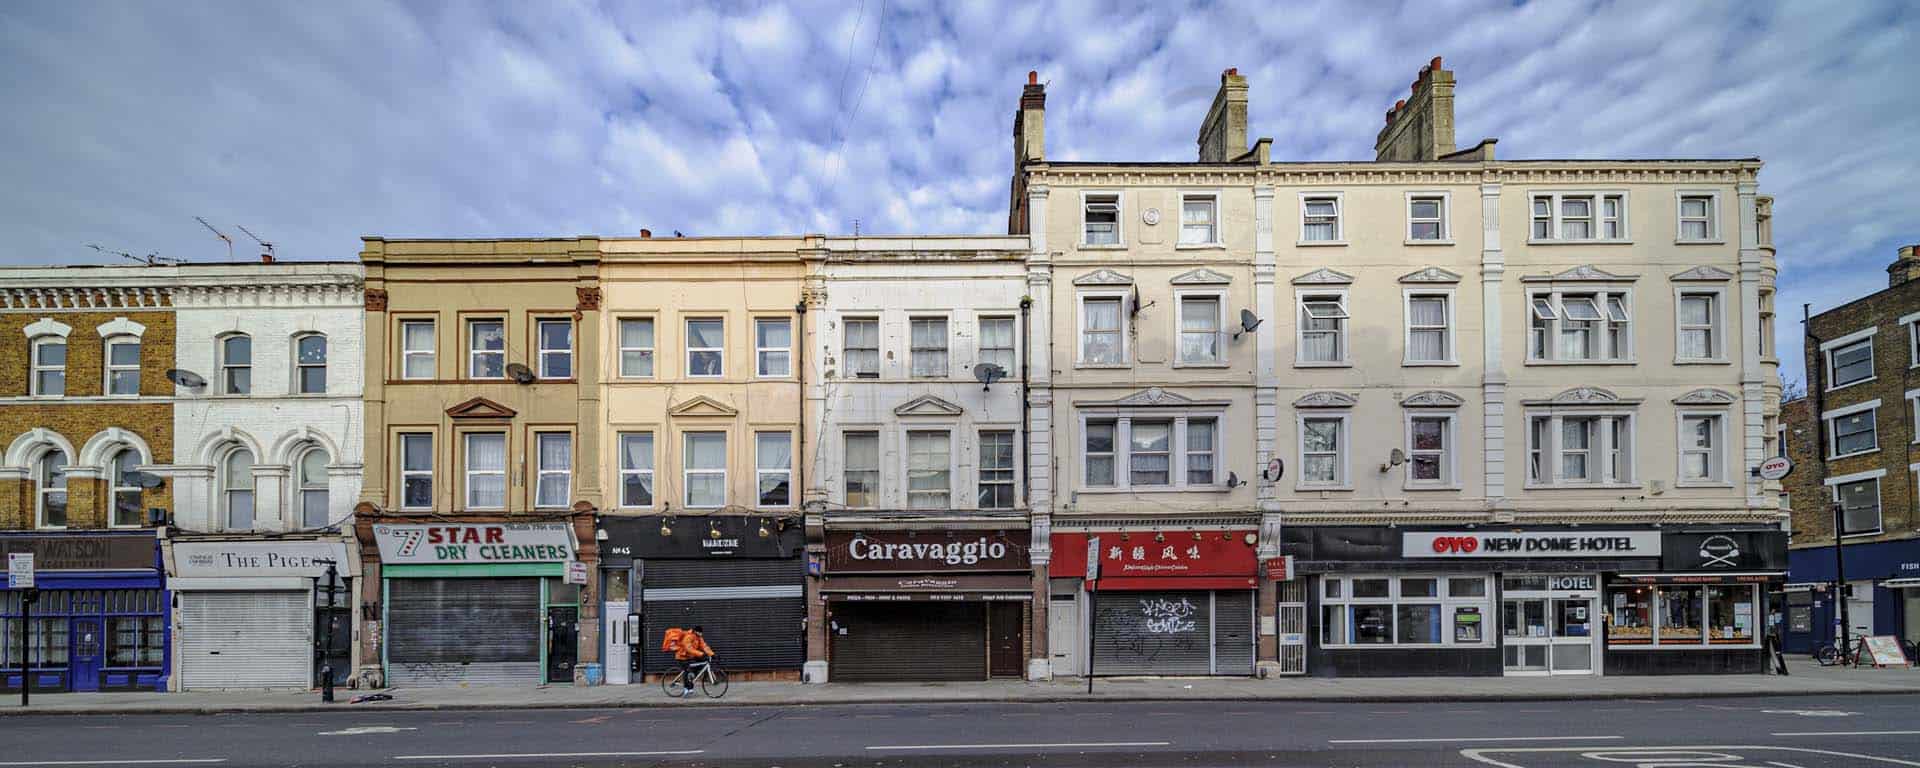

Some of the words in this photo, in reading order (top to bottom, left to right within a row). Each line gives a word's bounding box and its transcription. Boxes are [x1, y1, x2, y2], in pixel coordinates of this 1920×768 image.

[427, 527, 505, 544] STAR
[43, 540, 106, 559] WATSON
[435, 545, 468, 560] DRY
[479, 545, 568, 560] CLEANERS
[849, 537, 1006, 565] Caravaggio
[1432, 537, 1479, 554] OYO
[1484, 537, 1523, 554] NEW
[1525, 537, 1577, 553] DOME
[1579, 537, 1637, 552] HOTEL
[1551, 577, 1593, 590] HOTEL
